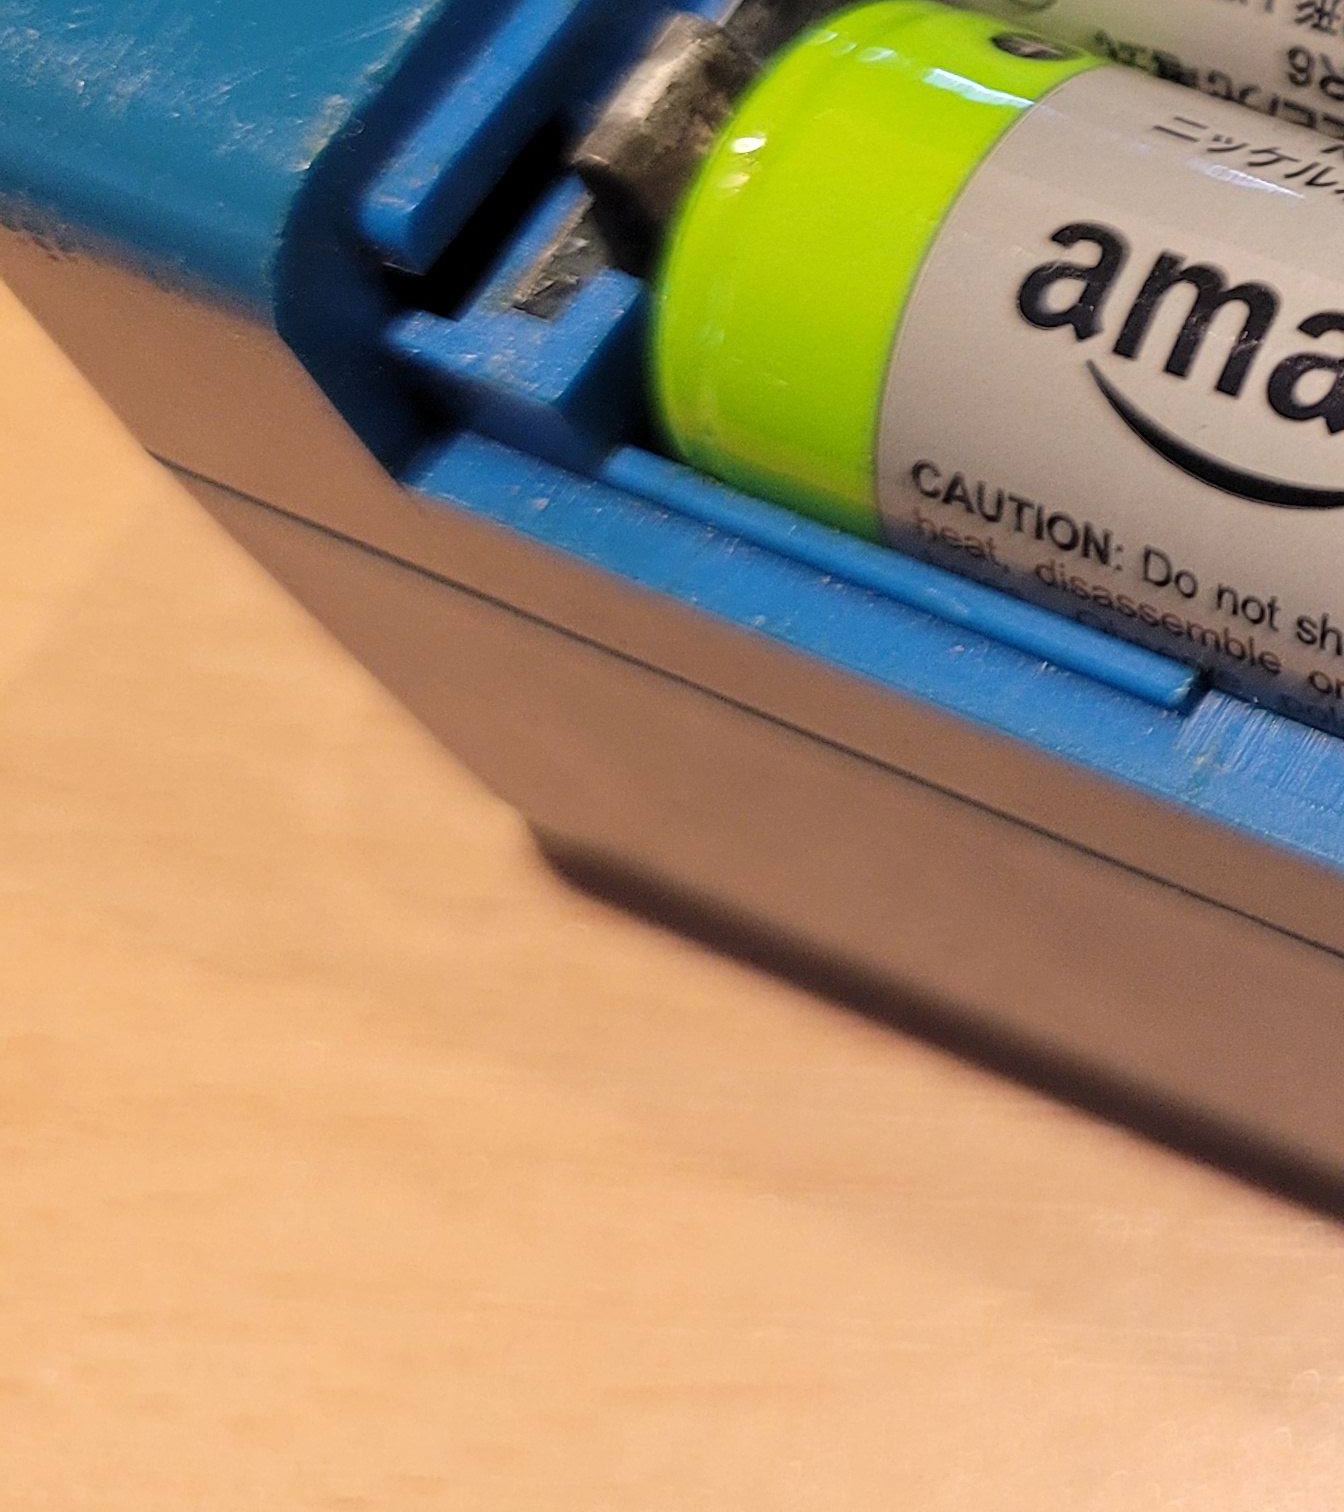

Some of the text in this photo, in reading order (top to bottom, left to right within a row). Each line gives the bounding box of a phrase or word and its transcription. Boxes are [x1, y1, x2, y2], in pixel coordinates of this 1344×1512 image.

[910, 458, 1124, 573] CAUTION:
[1142, 545, 1200, 600] Do
[1216, 583, 1283, 633] not
[910, 505, 1011, 573] heat,
[1035, 558, 1283, 676] disassemble
